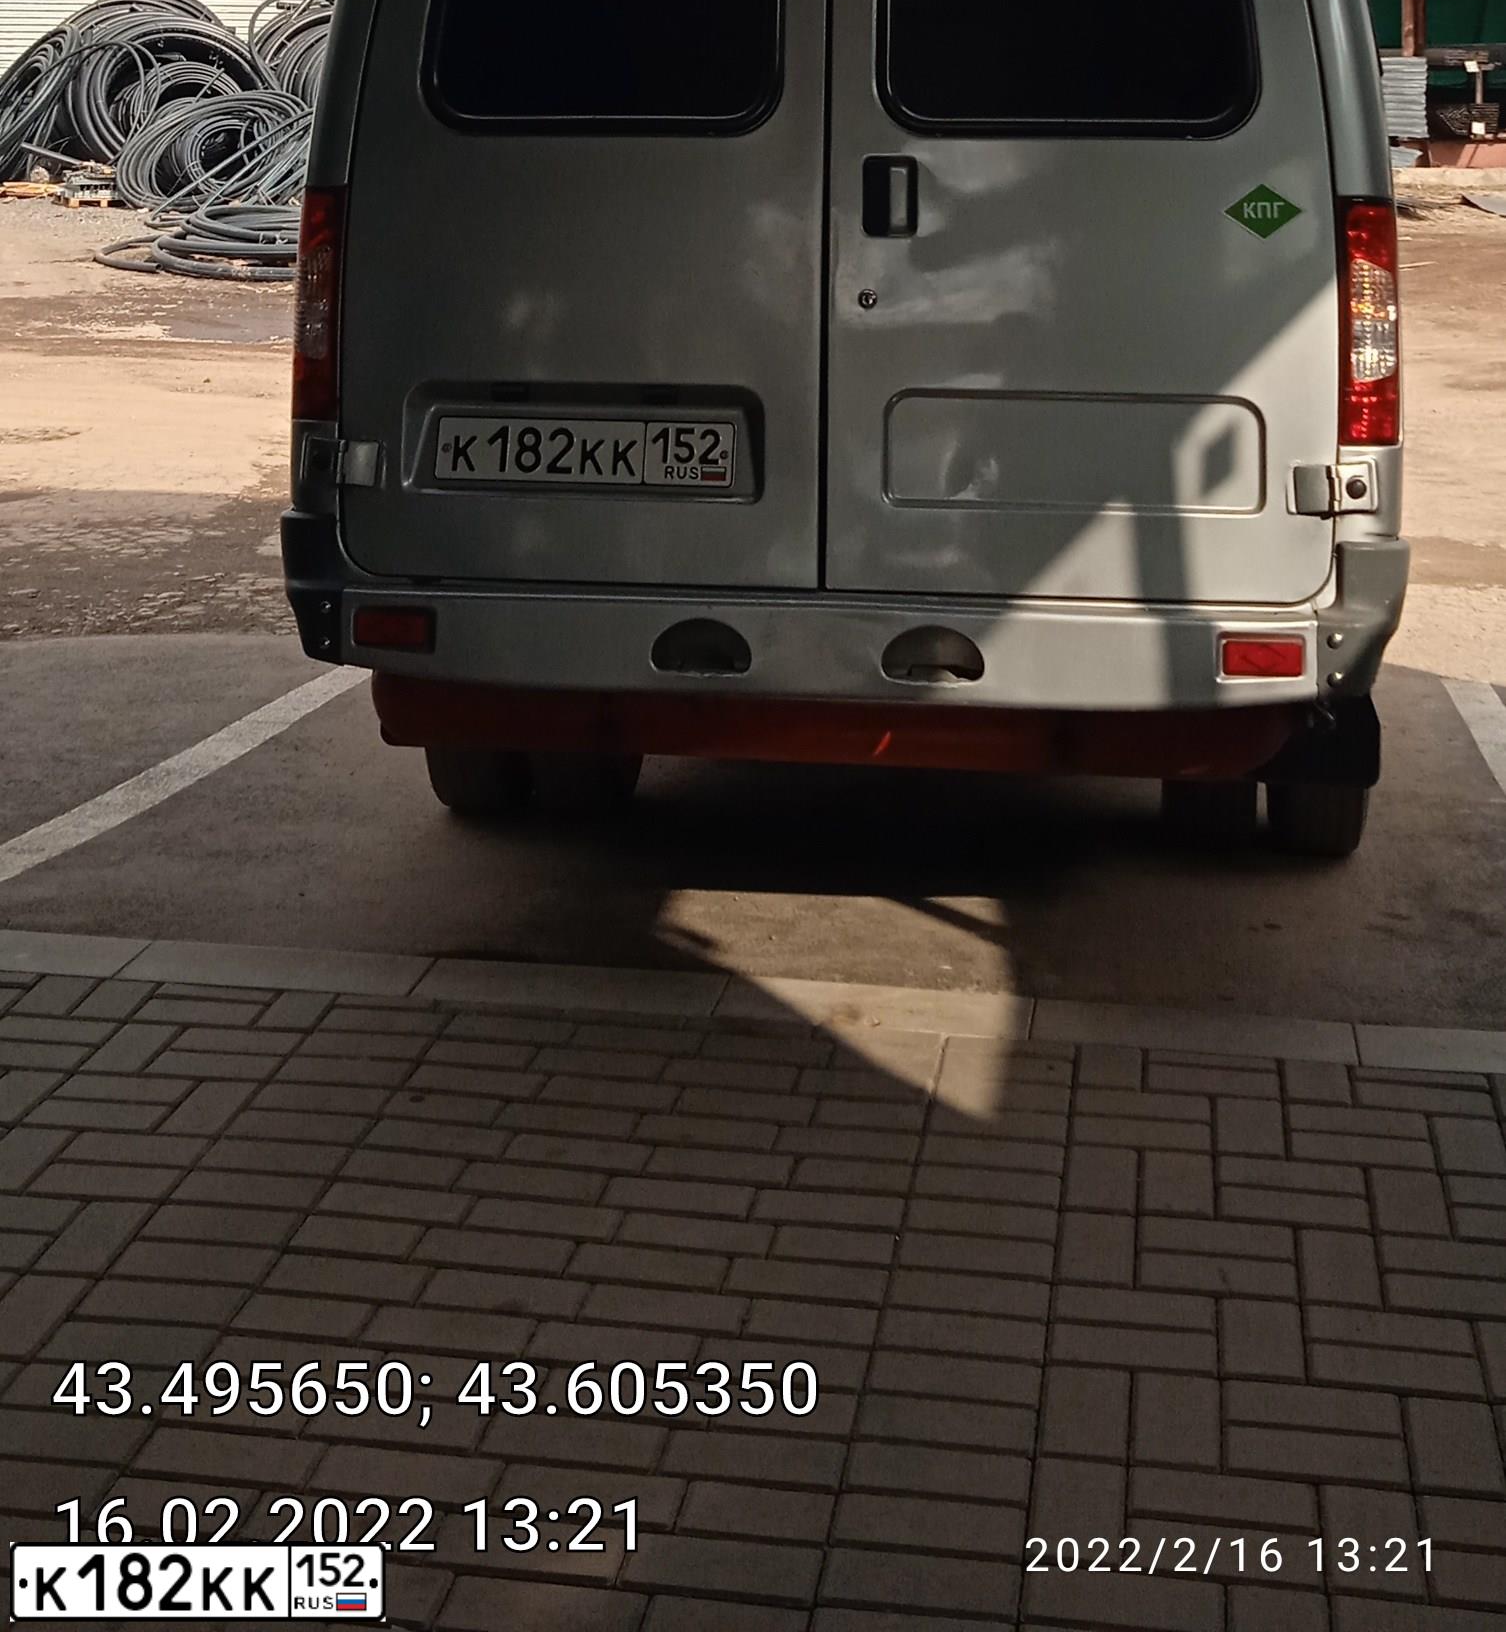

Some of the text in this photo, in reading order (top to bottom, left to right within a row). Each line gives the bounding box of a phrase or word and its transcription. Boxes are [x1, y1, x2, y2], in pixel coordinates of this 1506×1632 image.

[1243, 200, 1286, 220] КПГ
[651, 427, 722, 465] 152
[664, 465, 699, 480] RUS
